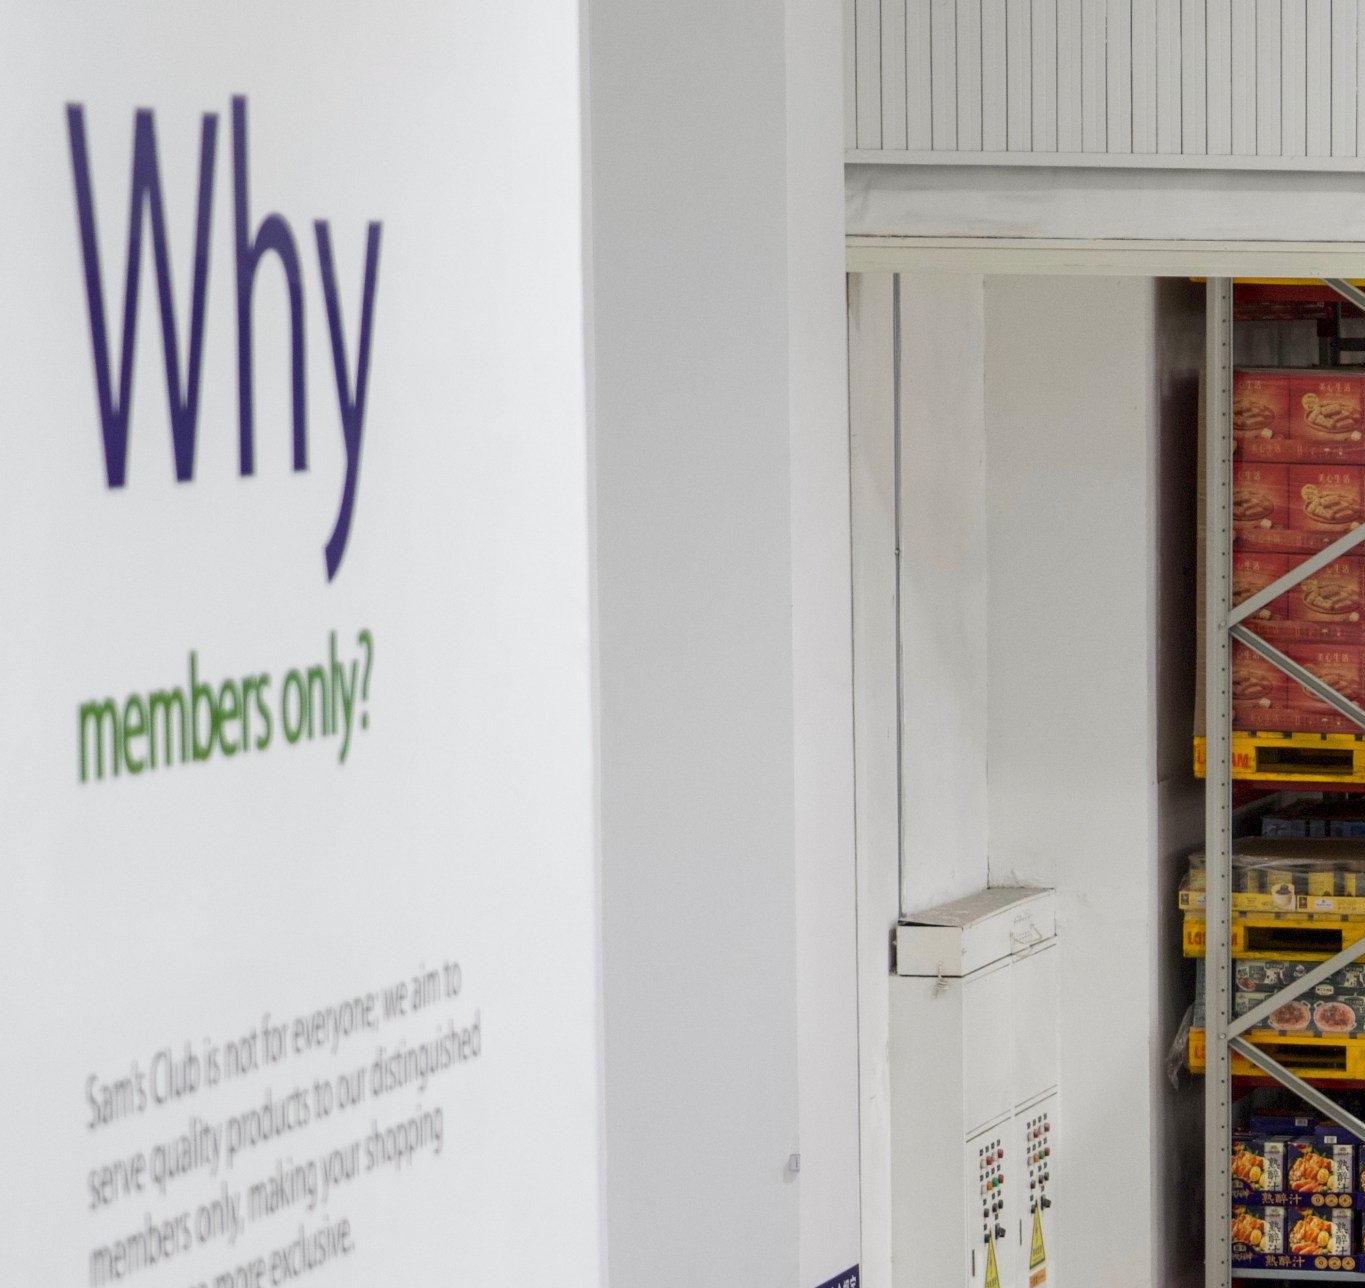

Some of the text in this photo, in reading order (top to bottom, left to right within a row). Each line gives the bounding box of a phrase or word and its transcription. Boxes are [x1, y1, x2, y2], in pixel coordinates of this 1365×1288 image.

[65, 94, 383, 585] Why
[77, 628, 375, 784] members only?
[86, 1060, 147, 1133] Sam's
[149, 1041, 201, 1108] Club
[204, 1037, 222, 1088] is
[223, 1027, 260, 1084] not
[261, 1011, 290, 1067] for
[381, 980, 410, 1021] we
[411, 962, 441, 1012] aim
[442, 959, 463, 1001] to
[87, 1009, 482, 1211] serve quality products to our distinguished
[194, 1181, 247, 1247] only,
[247, 1156, 318, 1213] making
[319, 1140, 362, 1205] your
[364, 1103, 444, 1172] shopping
[268, 1215, 356, 1288] exclusive.
